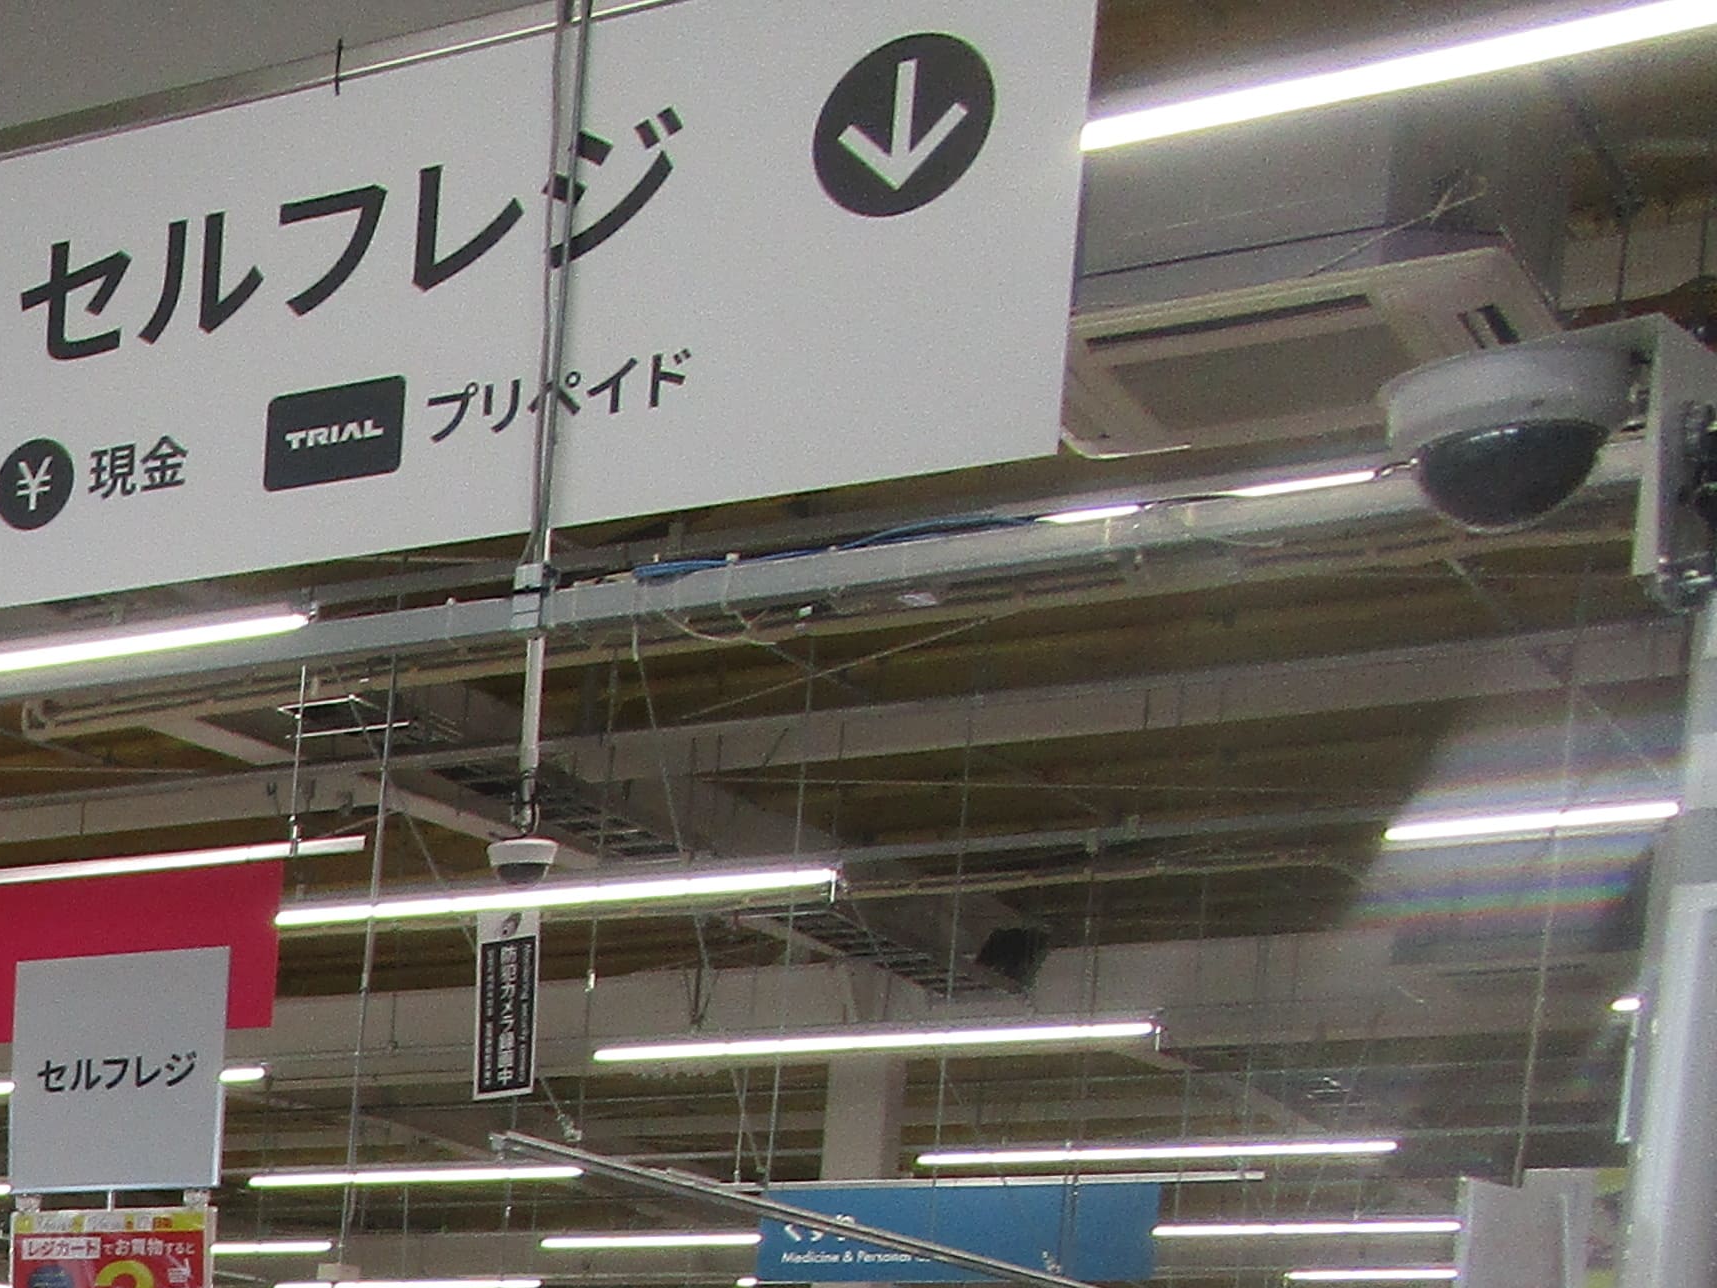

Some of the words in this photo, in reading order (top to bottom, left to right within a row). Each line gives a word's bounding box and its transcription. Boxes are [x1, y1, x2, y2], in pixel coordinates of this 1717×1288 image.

[20, 108, 685, 360] セルフレジ
[427, 348, 694, 443] プリペイド
[284, 418, 384, 452] TRIAL
[88, 435, 188, 500] 現金
[37, 1051, 197, 1094] セルフレジ
[781, 1249, 839, 1264] Medicine
